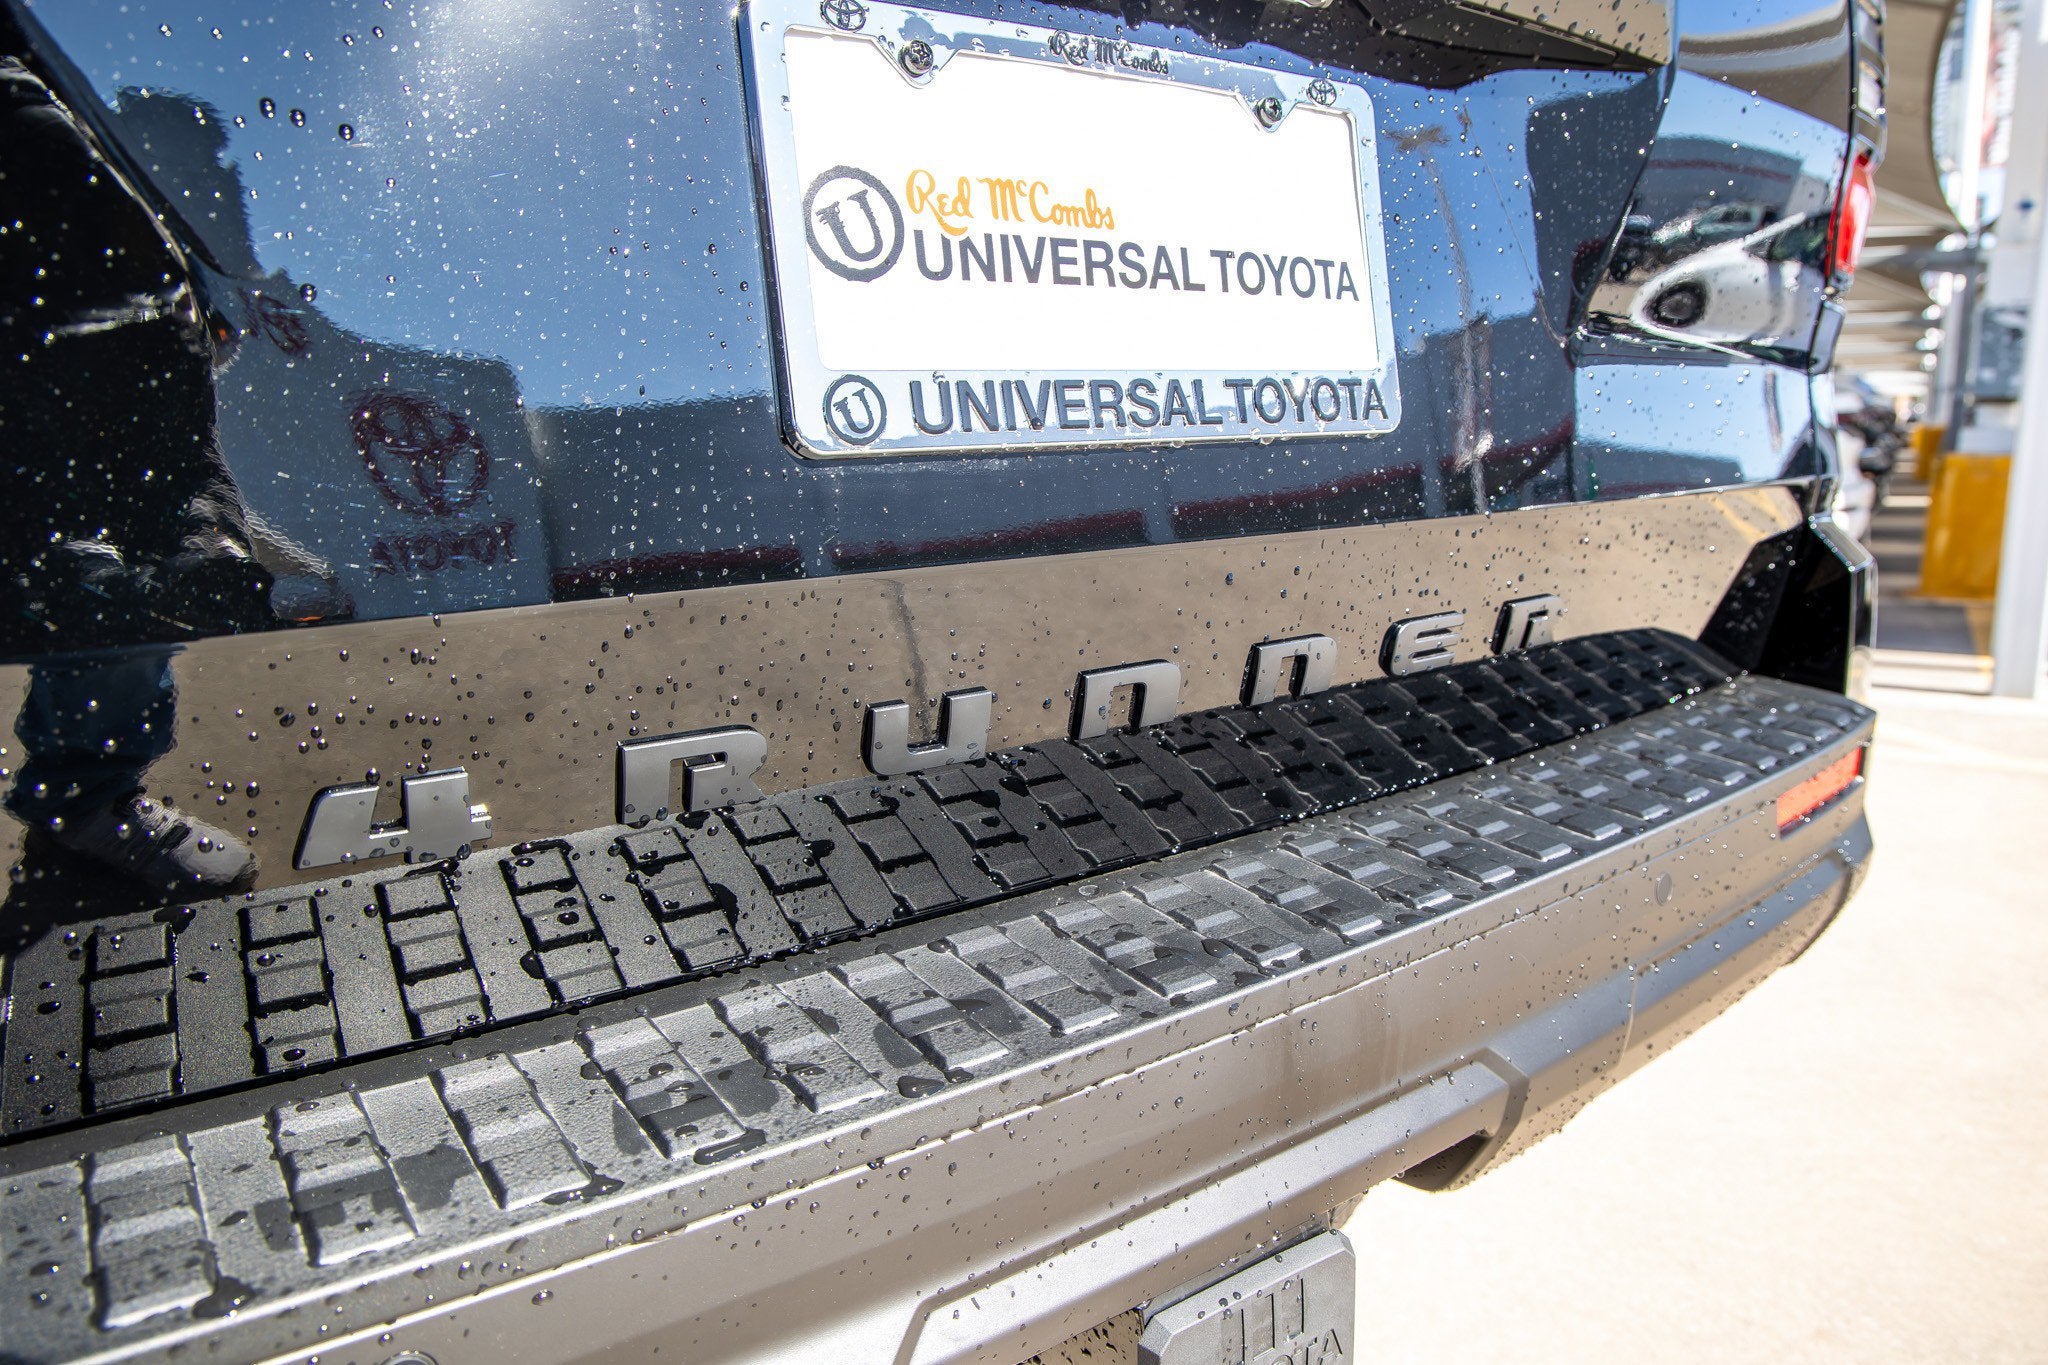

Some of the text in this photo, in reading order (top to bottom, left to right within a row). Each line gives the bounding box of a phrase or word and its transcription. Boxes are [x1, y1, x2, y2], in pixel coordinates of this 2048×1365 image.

[1047, 29, 1169, 75] Red McCombs
[906, 169, 1115, 236] Red McCombs
[913, 228, 1359, 302] UNIVERSAL TOYOTA
[909, 377, 1389, 435] UNIVERSAL TOYOTA
